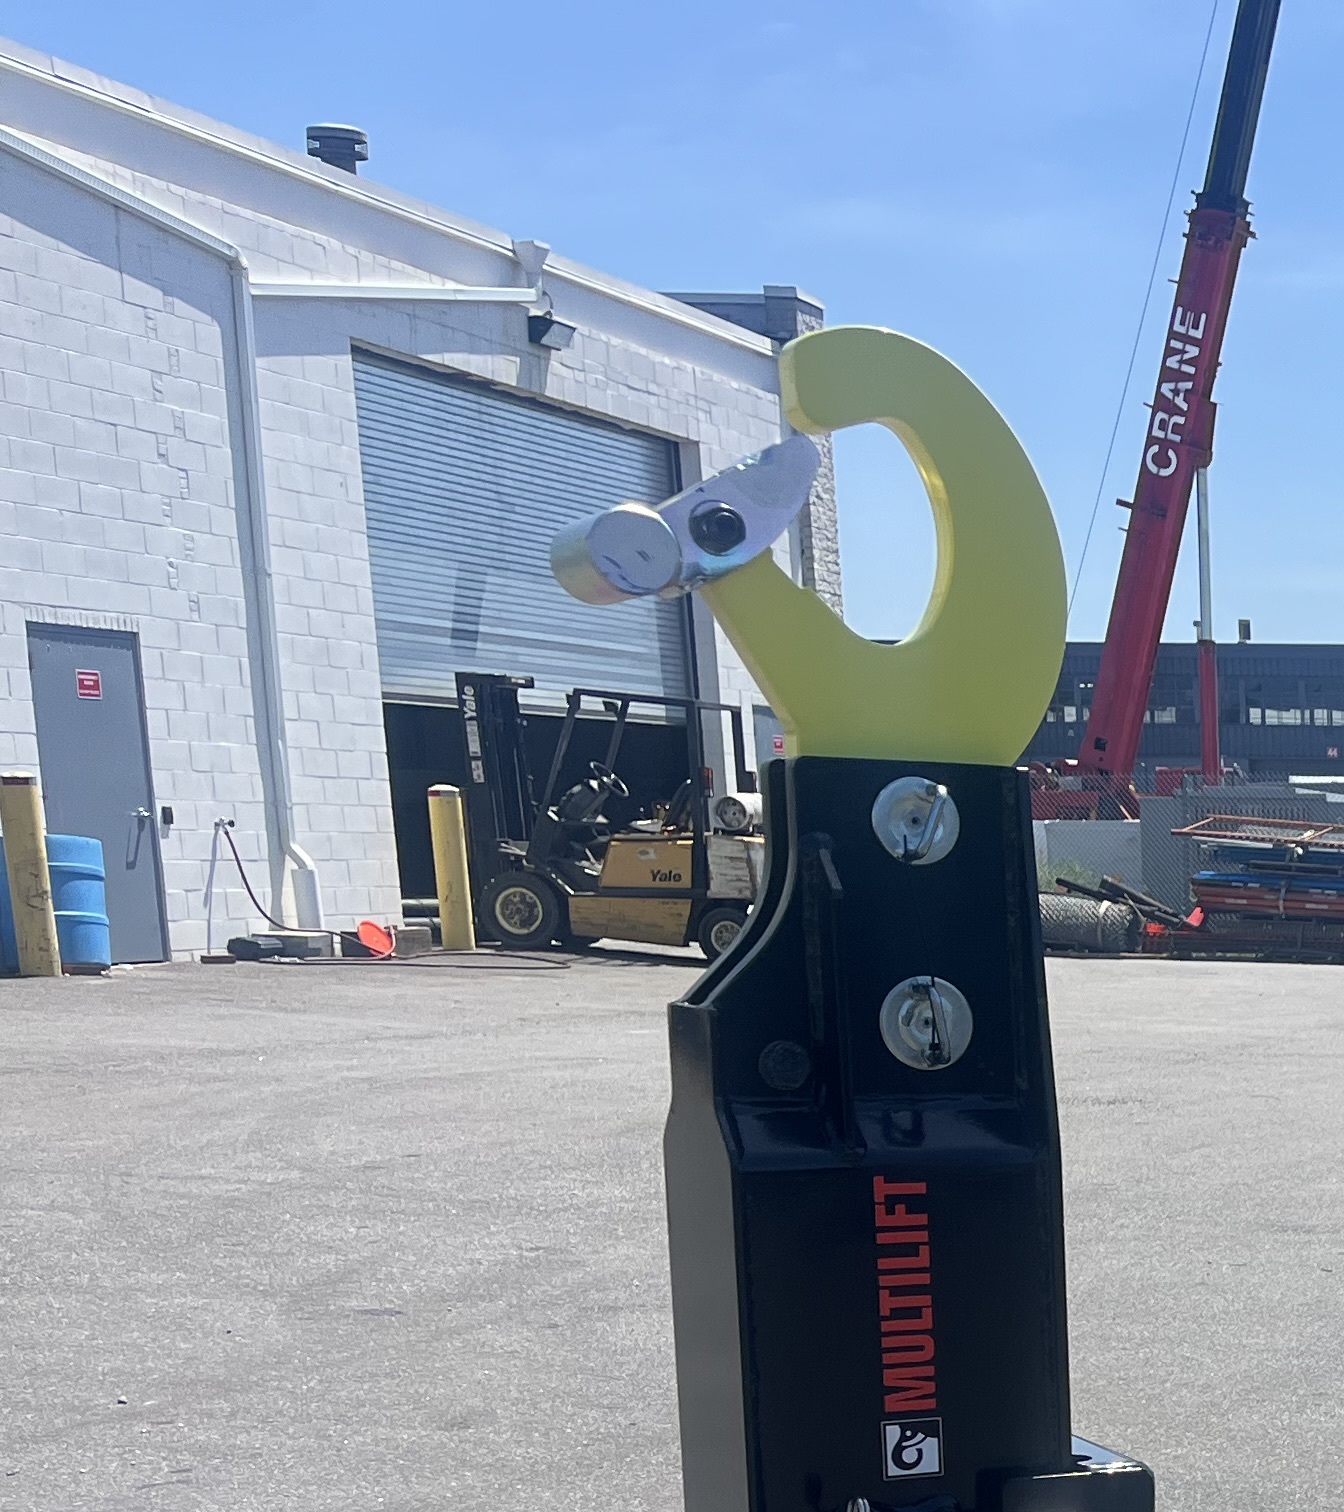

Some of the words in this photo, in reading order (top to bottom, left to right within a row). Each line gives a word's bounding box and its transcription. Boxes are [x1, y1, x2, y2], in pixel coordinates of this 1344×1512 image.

[1145, 305, 1207, 478] CRANE
[461, 685, 477, 719] Yale
[650, 869, 682, 882] Yale
[873, 1175, 937, 1413] MULTILIFT
